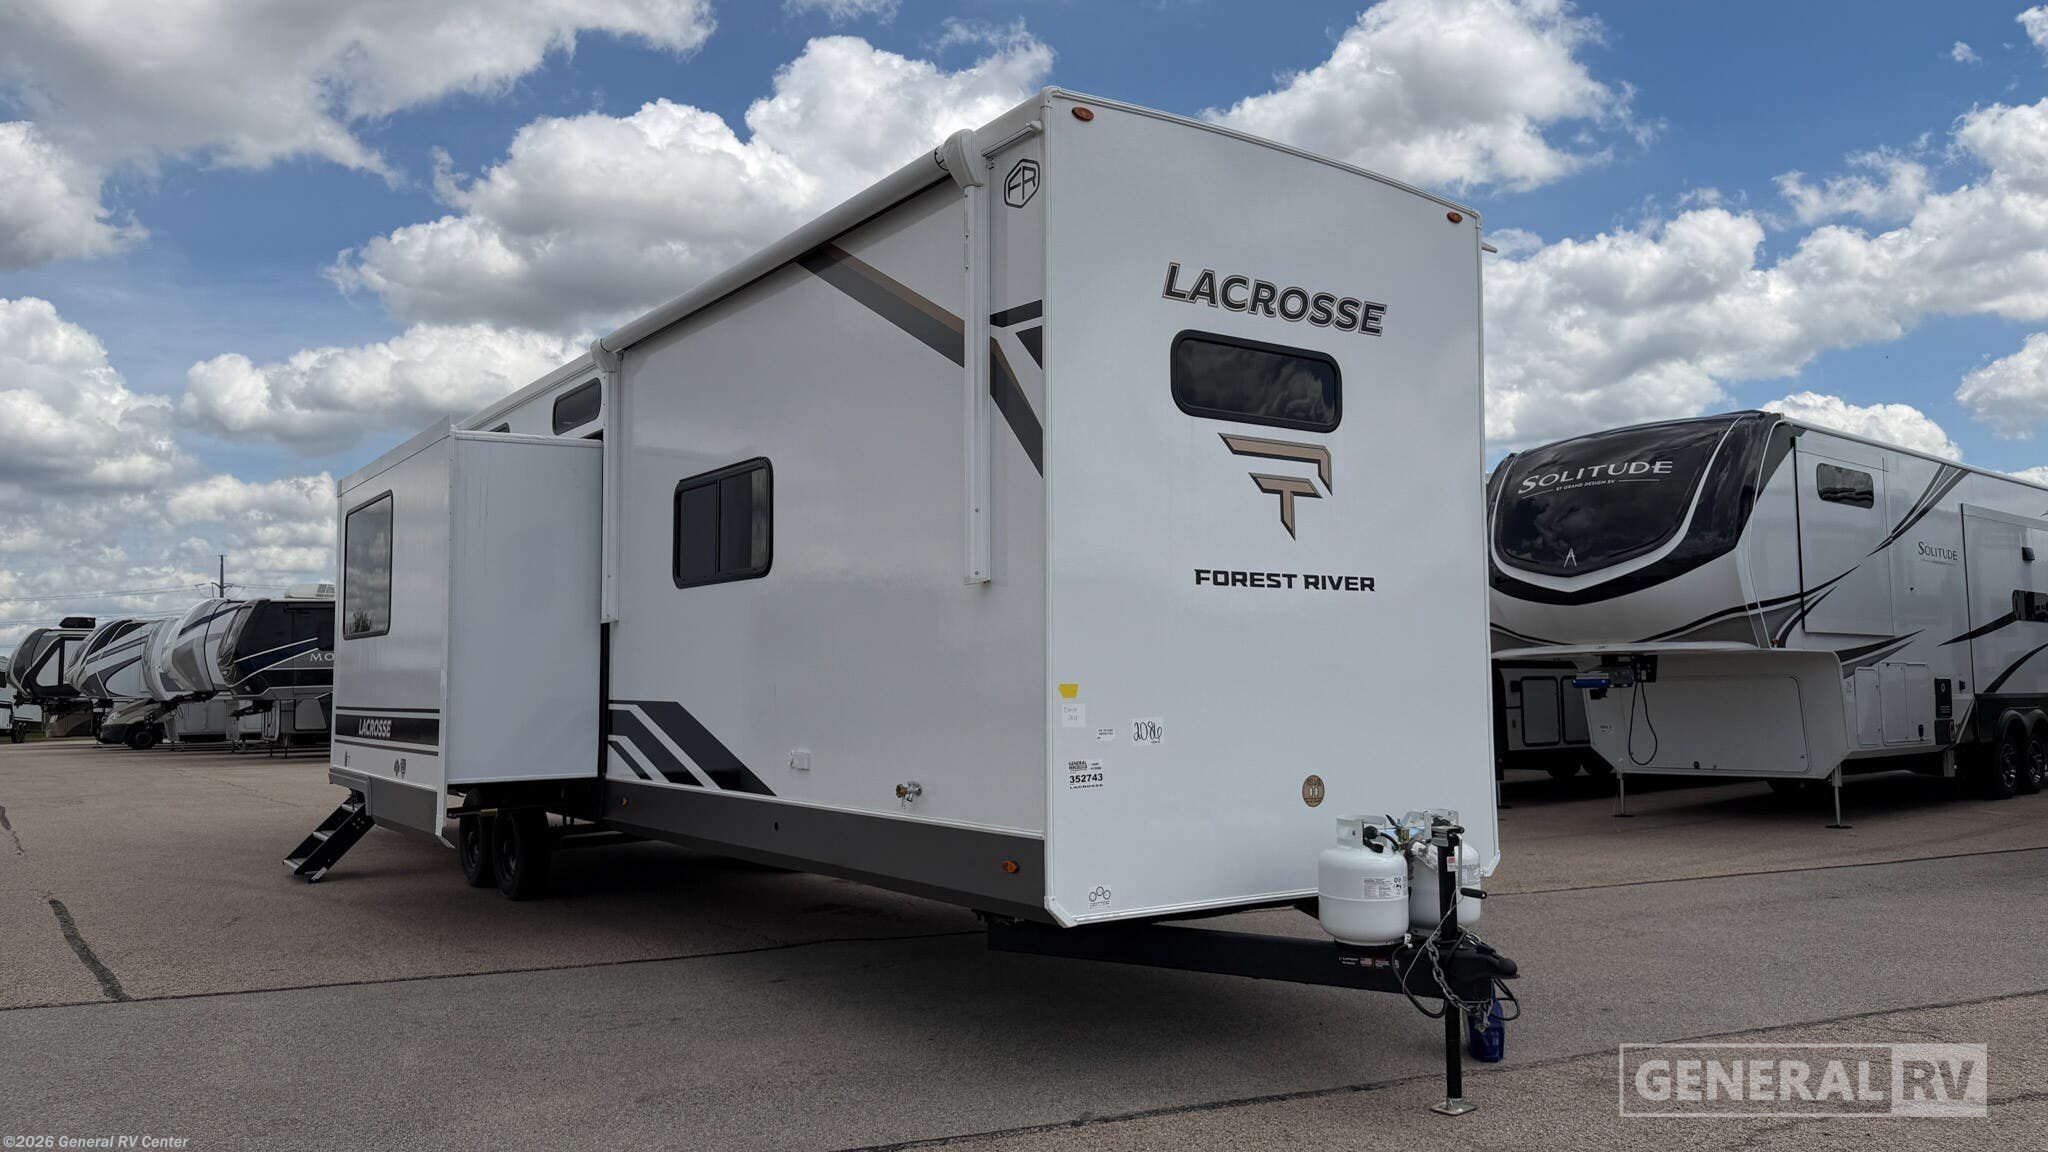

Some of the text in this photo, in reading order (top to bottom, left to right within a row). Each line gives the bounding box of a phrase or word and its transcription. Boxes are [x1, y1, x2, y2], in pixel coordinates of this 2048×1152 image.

[1162, 262, 1387, 337] LACROSSE
[1518, 461, 1673, 494] SOLITUDE
[1564, 482, 1582, 490] GRAND
[1584, 480, 1606, 488] DESIGN
[1918, 541, 1958, 561] SOLITUDE
[1194, 569, 1376, 592] FOREST RIVER
[359, 718, 392, 738] LACROSSE
[1069, 773, 1103, 784] 352743
